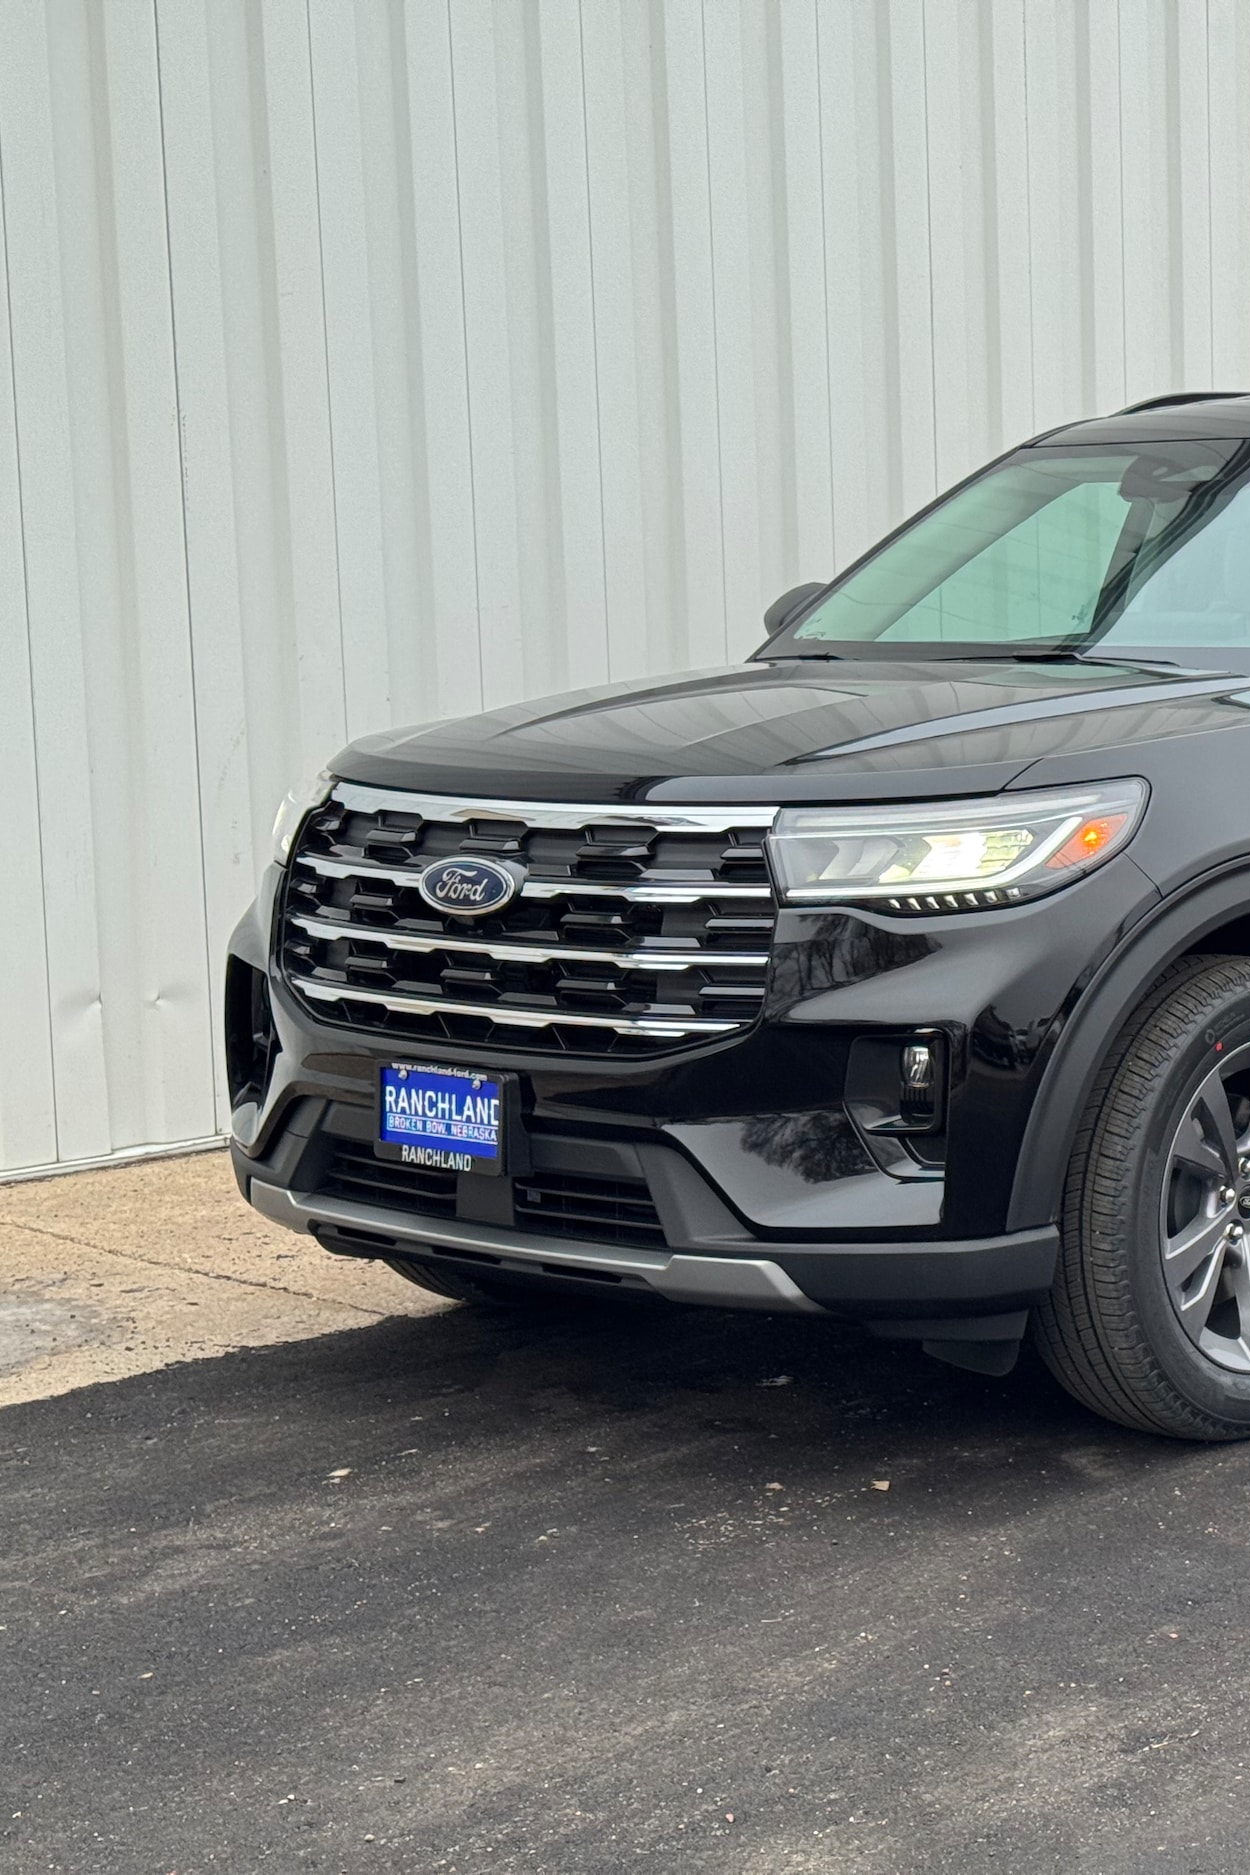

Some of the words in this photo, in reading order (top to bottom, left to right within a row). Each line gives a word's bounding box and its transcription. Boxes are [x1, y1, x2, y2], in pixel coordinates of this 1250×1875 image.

[435, 867, 488, 901] Ford
[388, 1116, 423, 1131] BROKEN
[450, 1124, 498, 1142] NEBRASKA
[401, 1144, 472, 1172] RANCHLAND
